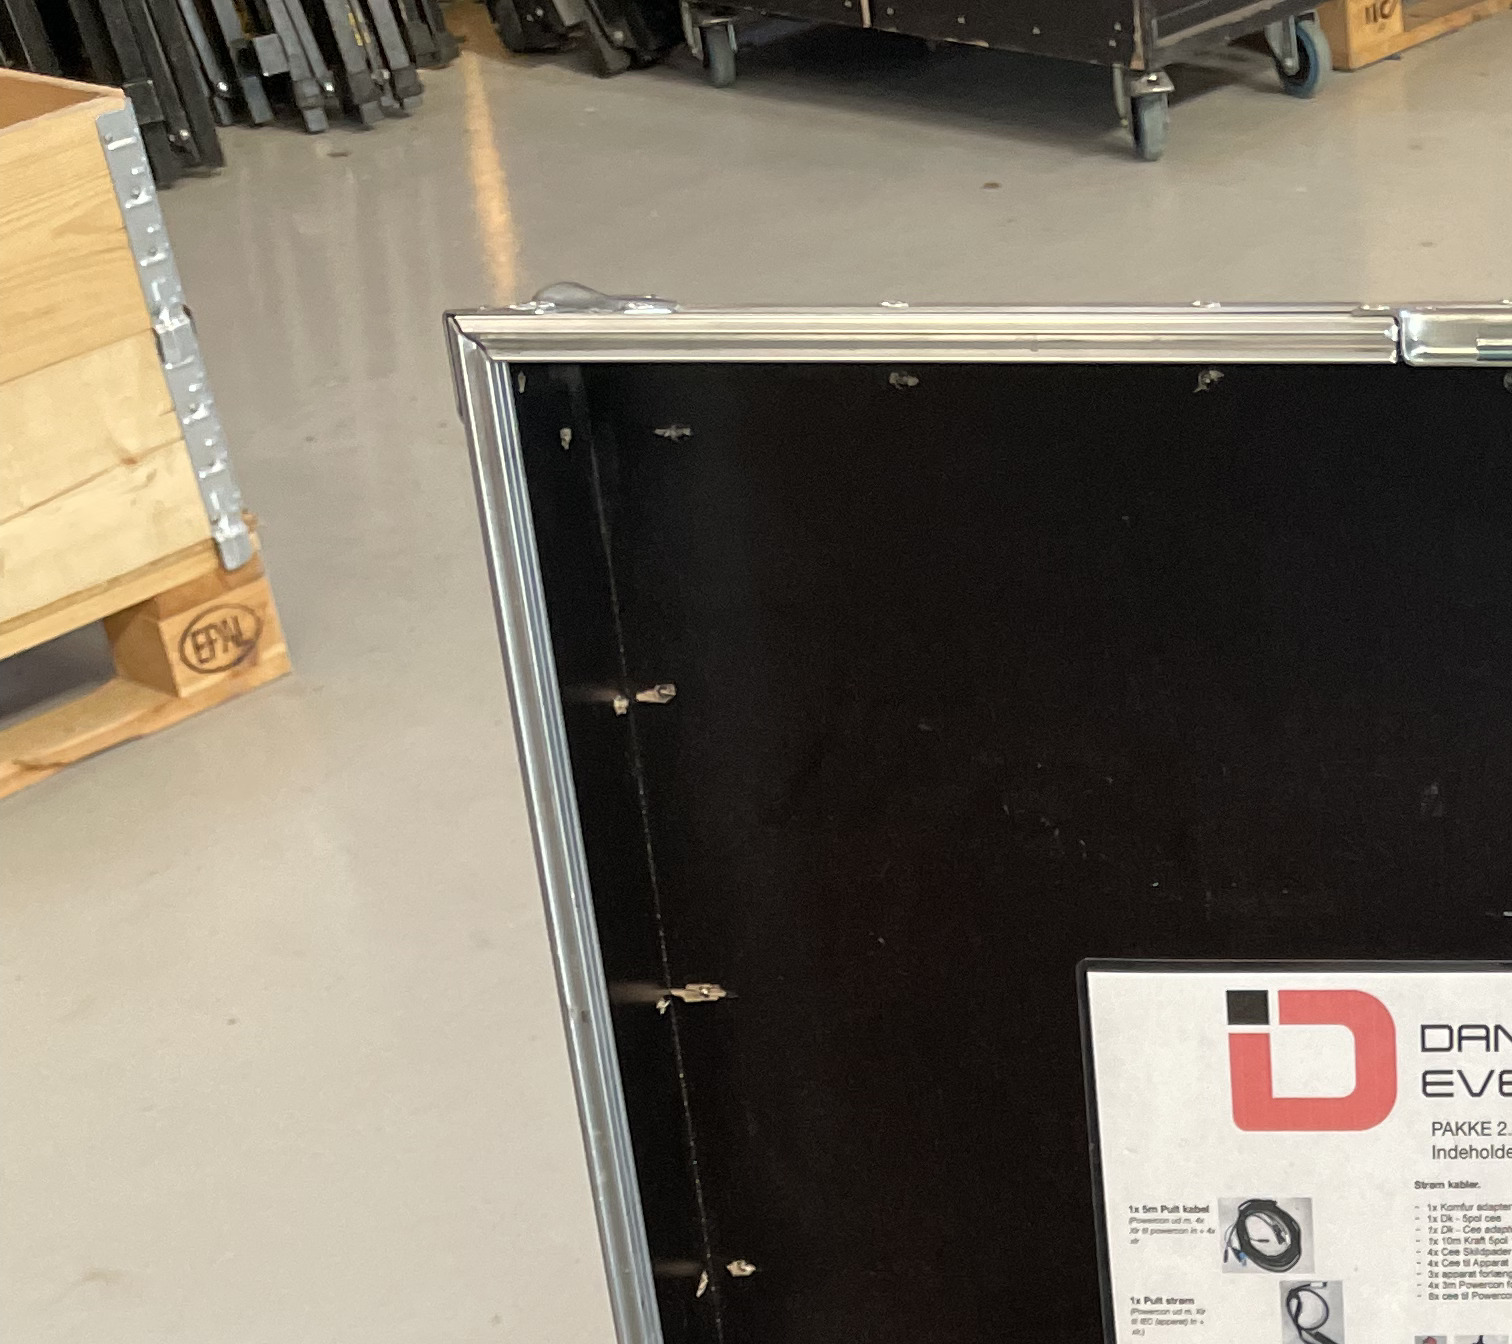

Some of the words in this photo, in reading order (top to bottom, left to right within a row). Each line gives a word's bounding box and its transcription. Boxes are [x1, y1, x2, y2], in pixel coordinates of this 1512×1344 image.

[1431, 1121, 1492, 1137] PAKKE
[1496, 1121, 1512, 1137] 2.
[1427, 1203, 1438, 1212] 1x
[1440, 1203, 1474, 1212] Komfur
[1476, 1203, 1512, 1212] adapter
[1427, 1215, 1438, 1223] 1x
[1427, 1248, 1439, 1256] 4x
[1427, 1259, 1439, 1267] 4x
[1427, 1280, 1439, 1289] 4x
[1458, 1280, 1505, 1289] Powercon
